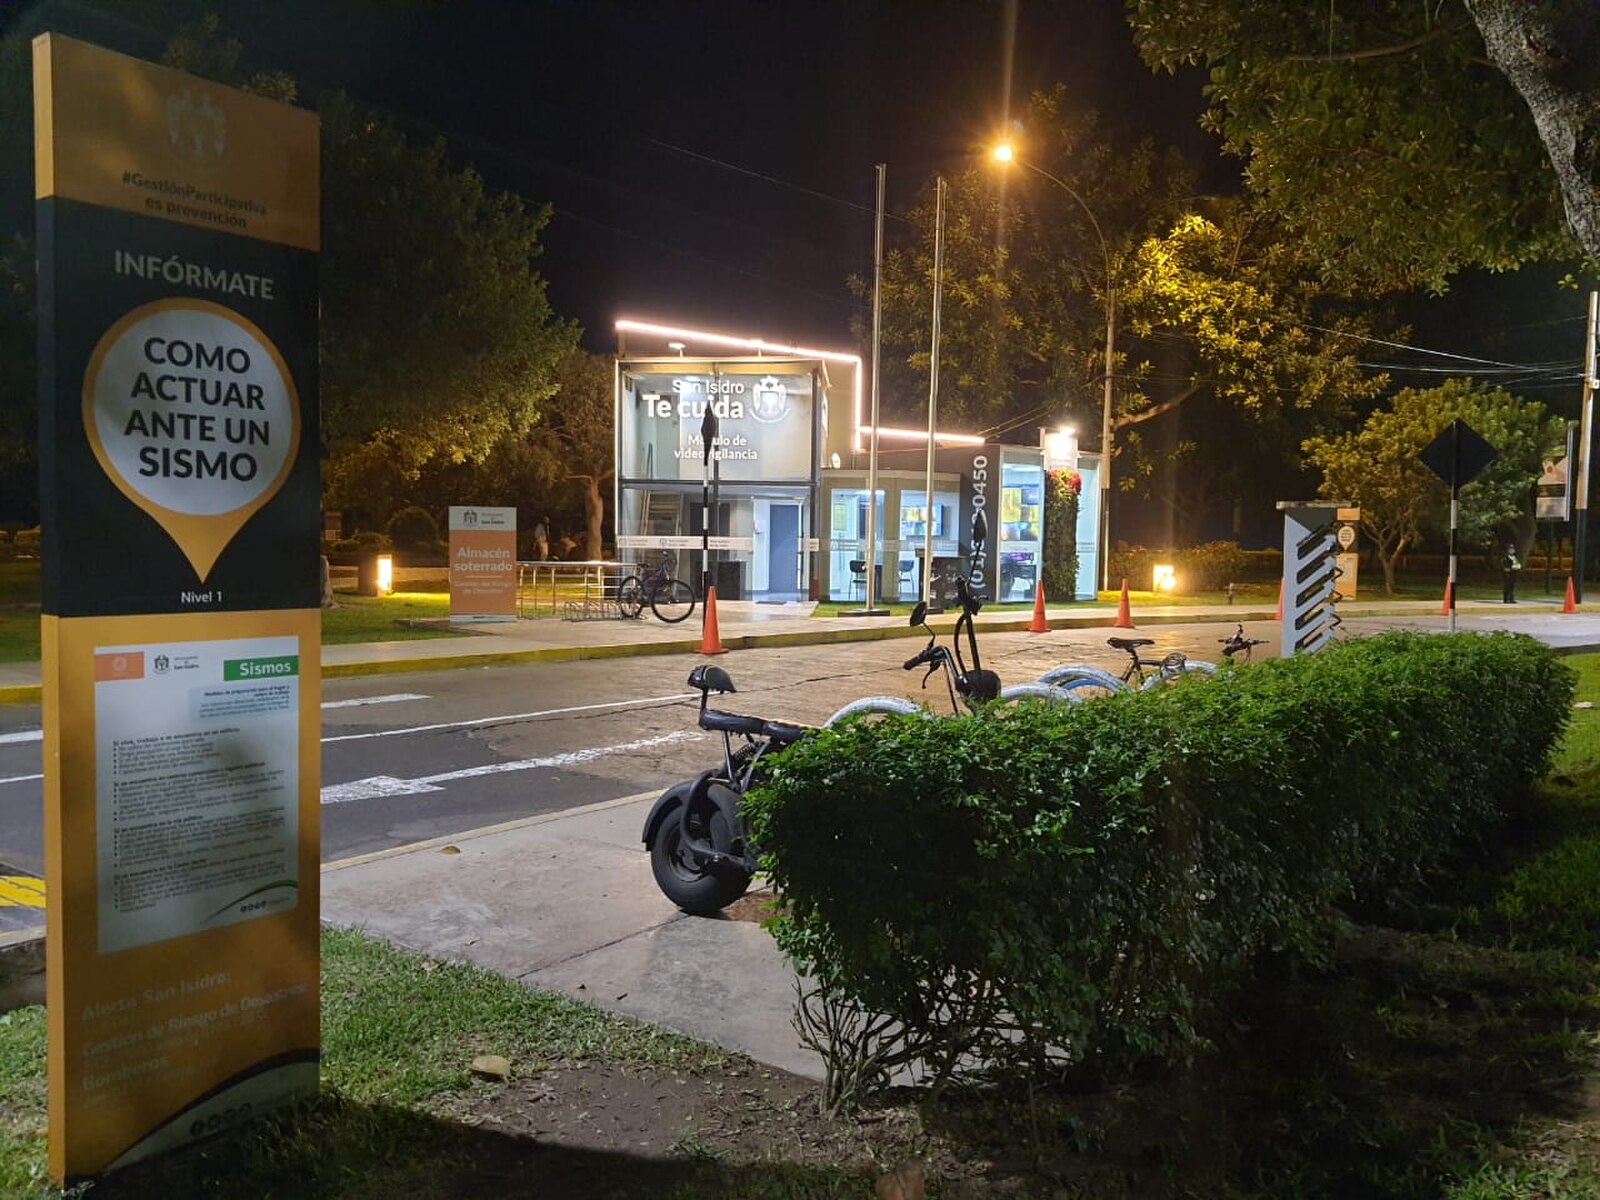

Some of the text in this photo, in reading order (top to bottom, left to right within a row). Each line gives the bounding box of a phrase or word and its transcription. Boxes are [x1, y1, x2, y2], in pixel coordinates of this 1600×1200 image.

[146, 197, 247, 229] es prevención
[115, 250, 274, 299] INFÓRMATE
[144, 337, 250, 374] COMO
[130, 371, 266, 411] ACTUAR
[672, 379, 745, 394] Sn Isidro
[642, 394, 672, 418] Te
[123, 409, 270, 446] ANTE UN
[688, 434, 747, 446] Mulo de
[138, 445, 258, 482] SISMO
[457, 546, 511, 559] Almacén
[454, 560, 513, 572] soterrado
[180, 591, 223, 604] Nivel 1
[239, 661, 291, 677] Sismos
